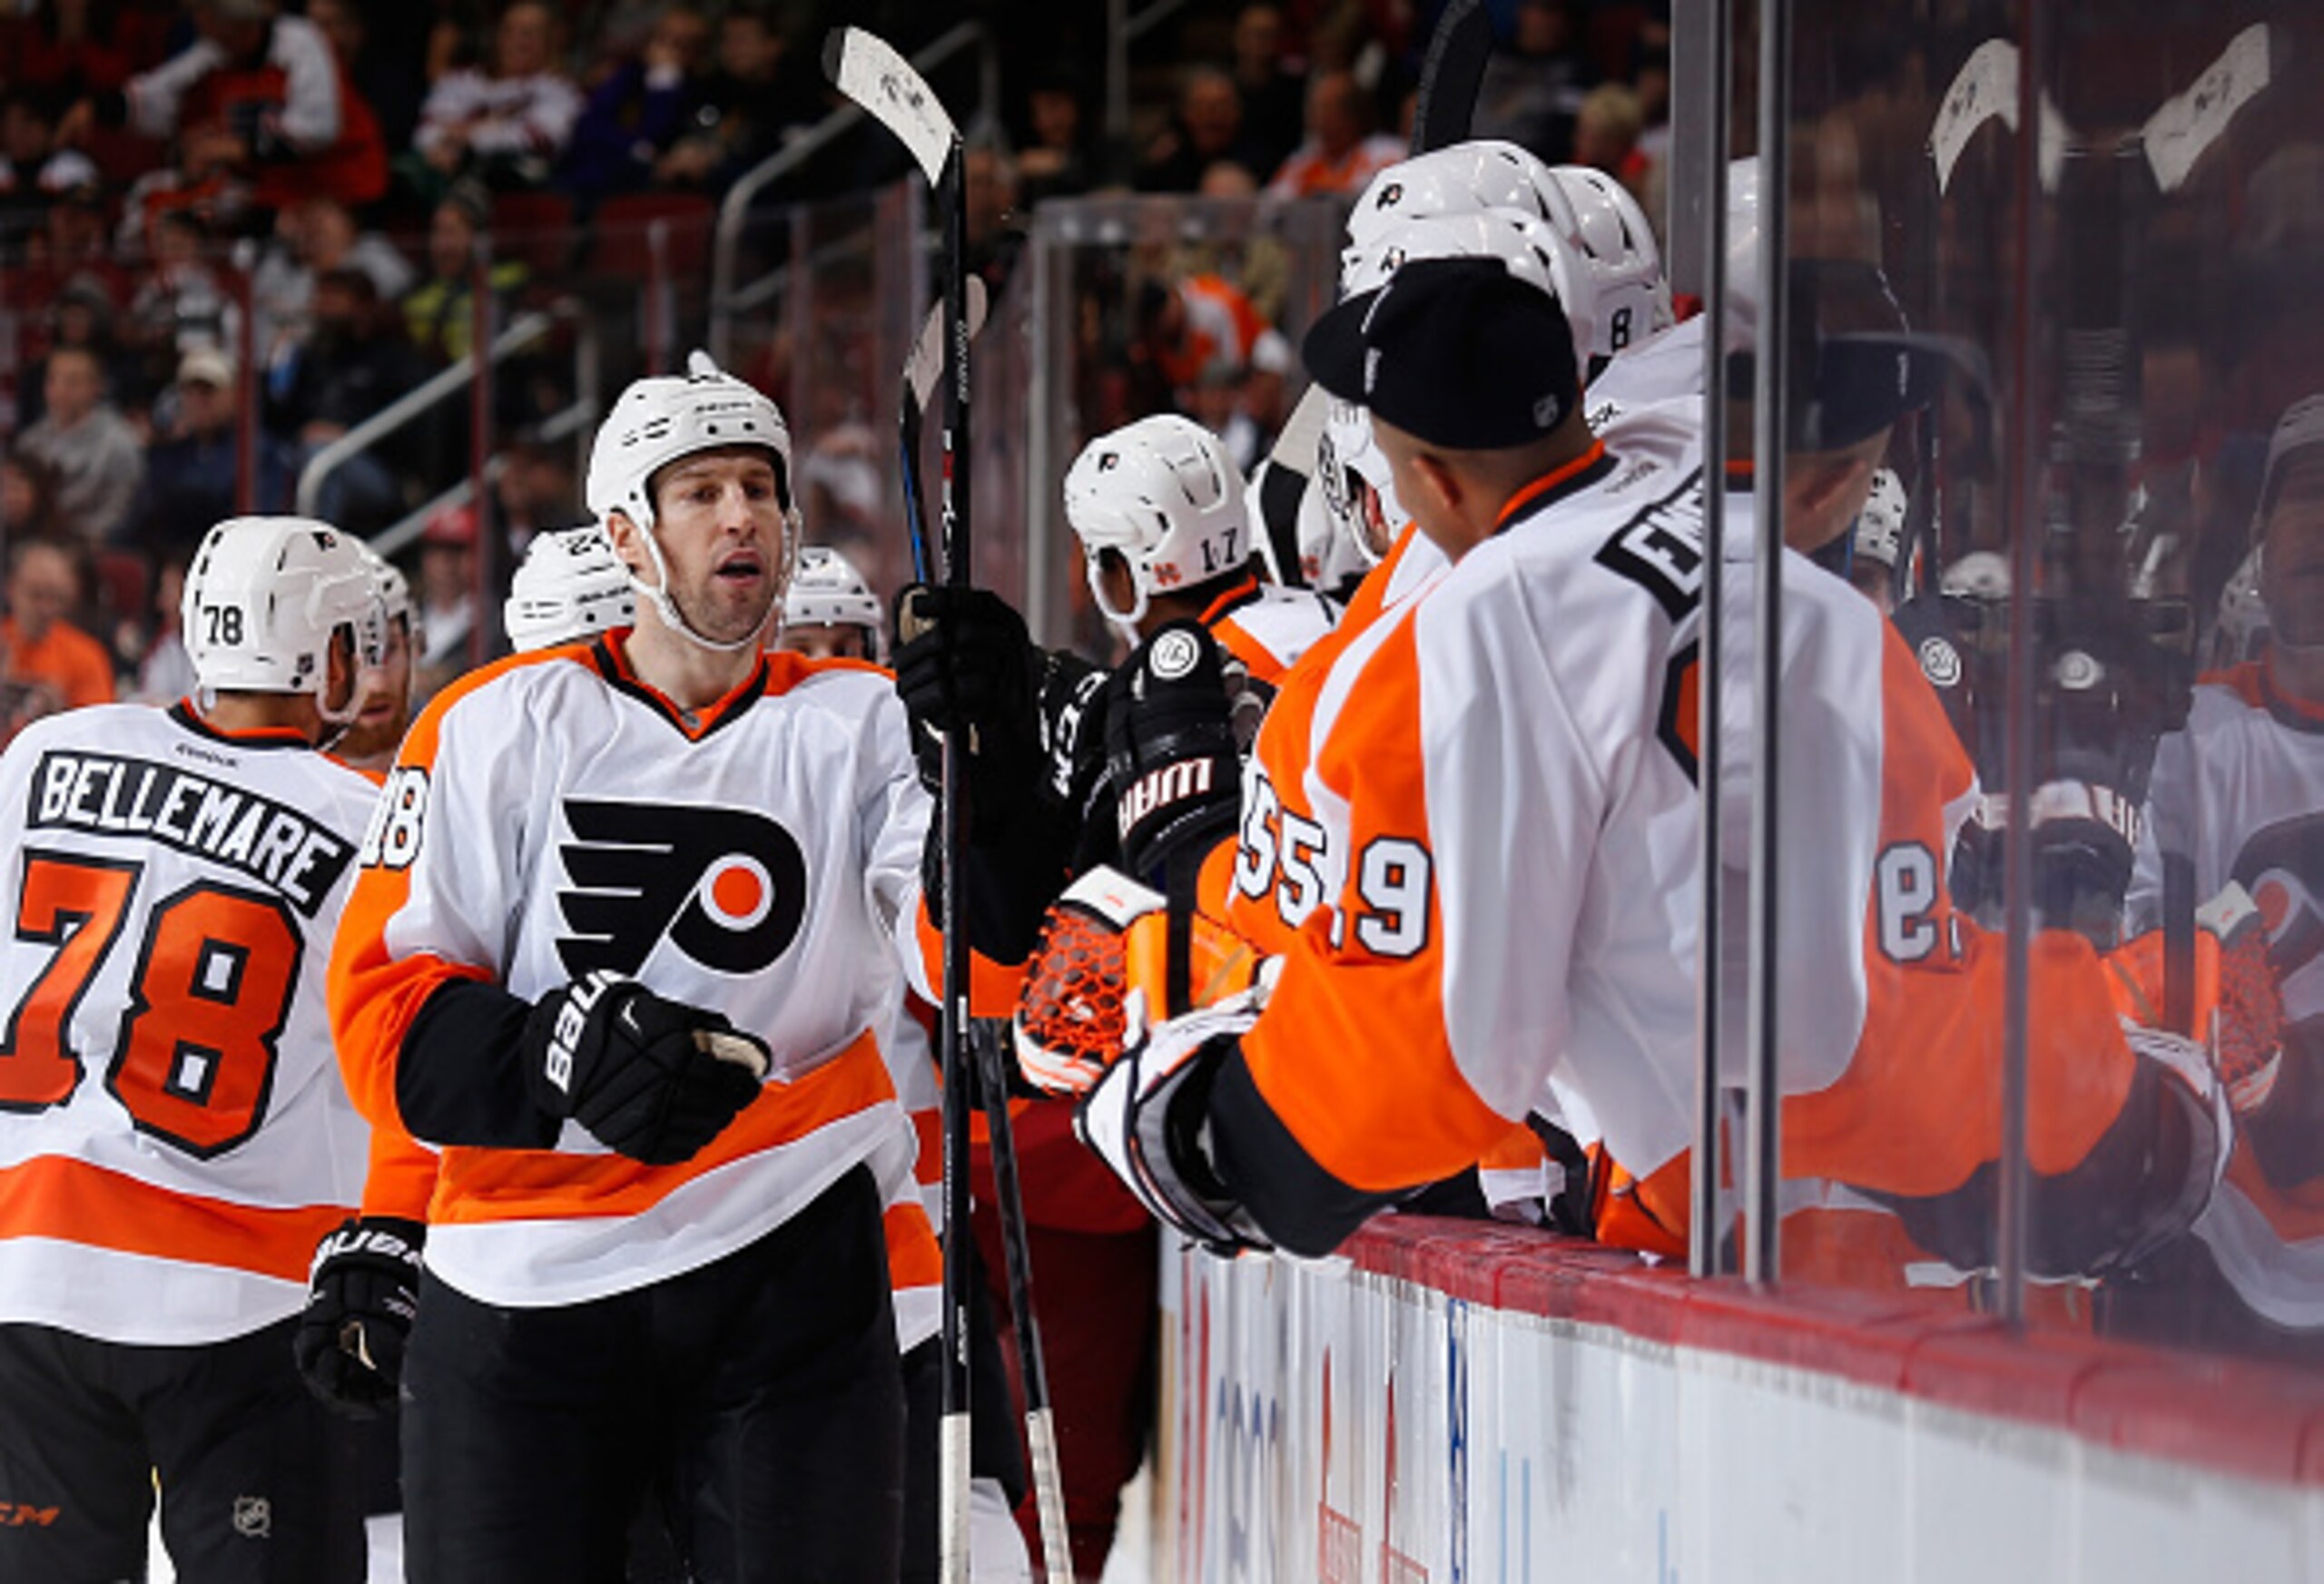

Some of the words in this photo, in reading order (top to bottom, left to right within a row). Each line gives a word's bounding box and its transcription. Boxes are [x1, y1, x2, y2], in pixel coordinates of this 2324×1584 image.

[1200, 526, 1238, 573] 17
[202, 605, 244, 646] 78
[38, 756, 340, 906] BELLEMARE
[1236, 773, 1328, 931] 55
[0, 846, 306, 1163] 78
